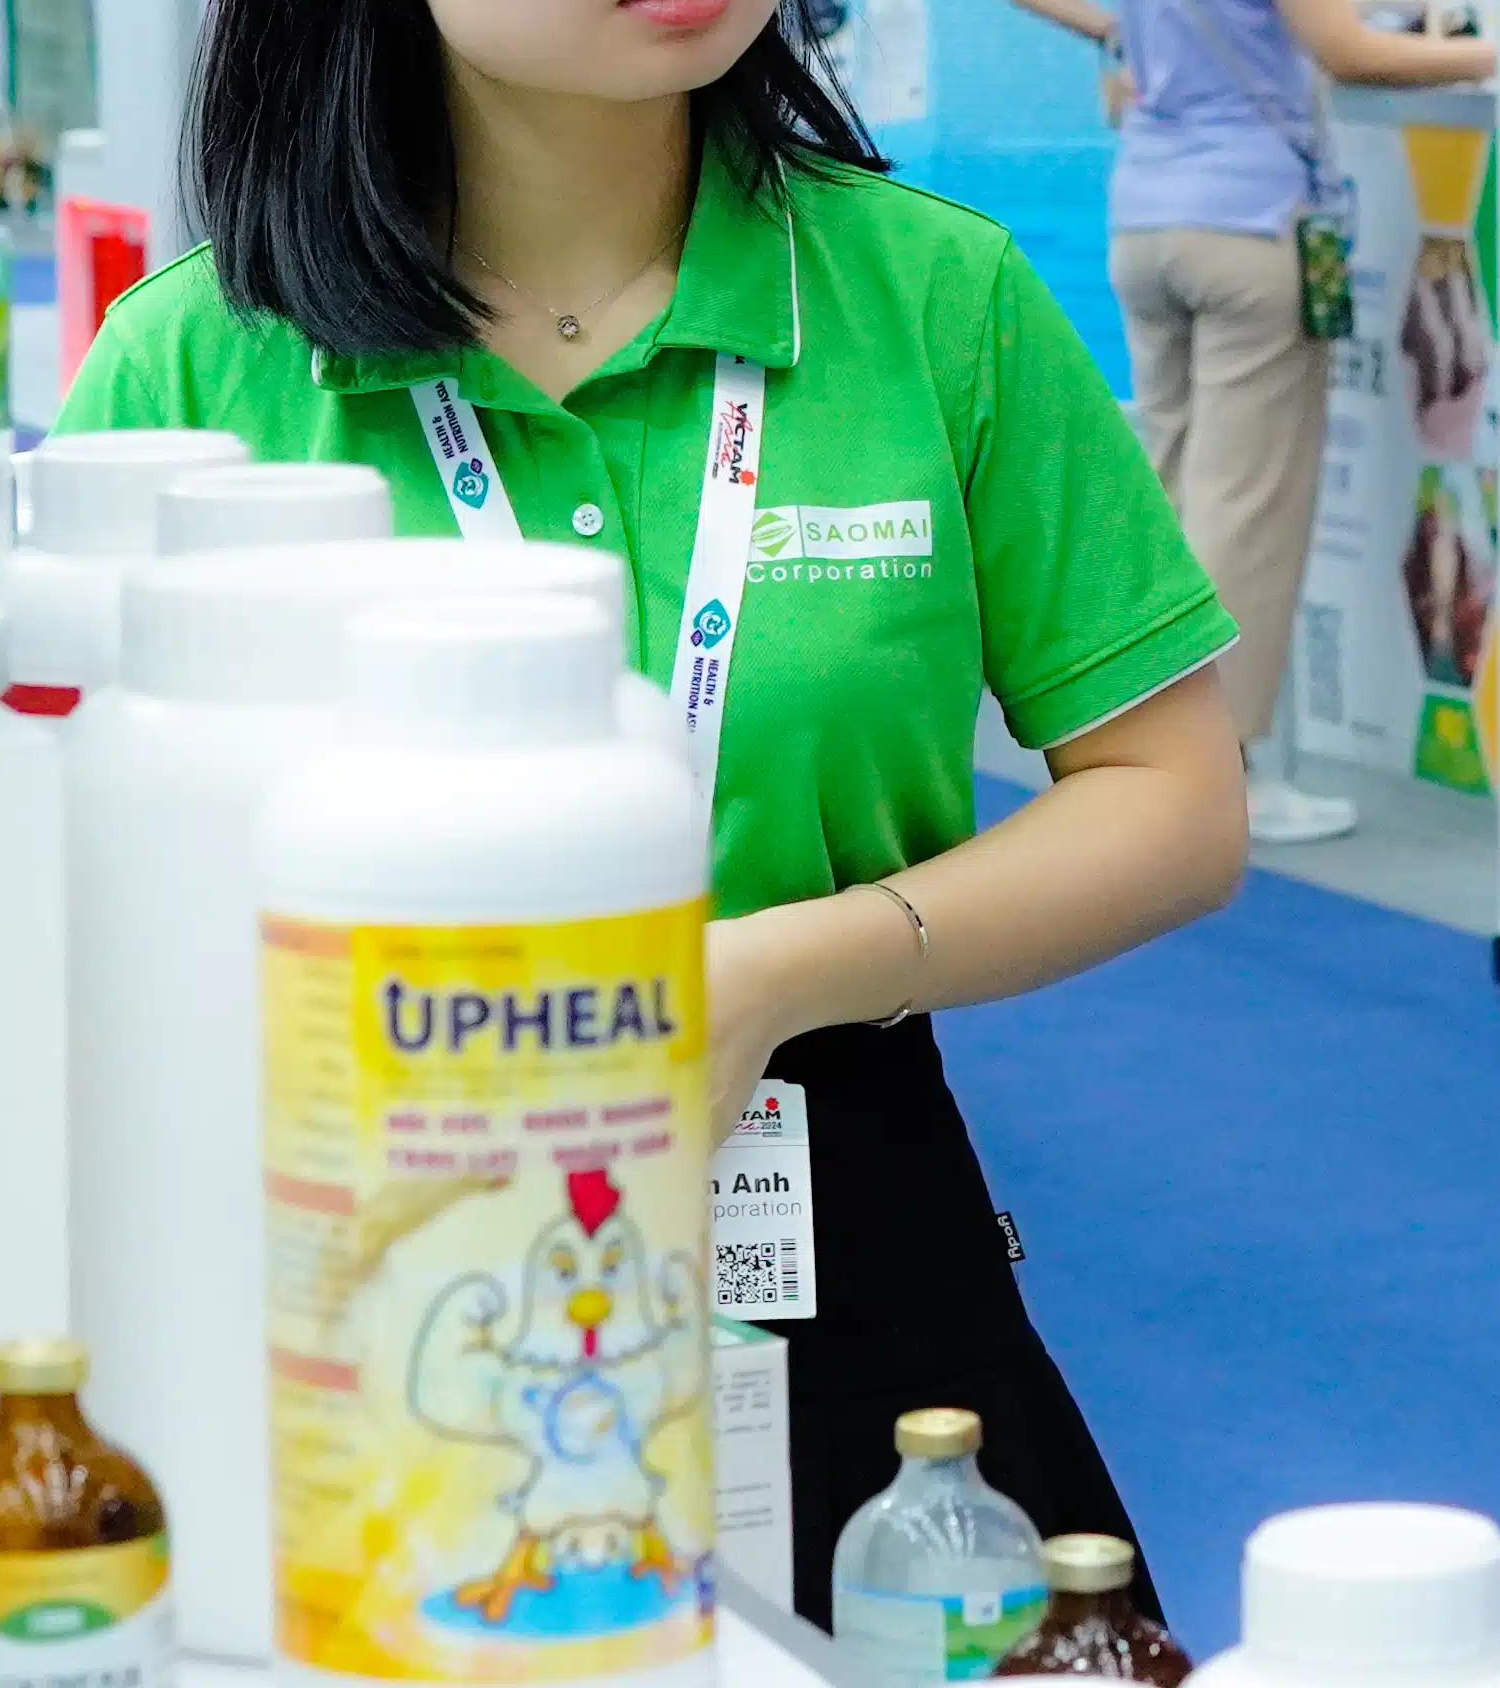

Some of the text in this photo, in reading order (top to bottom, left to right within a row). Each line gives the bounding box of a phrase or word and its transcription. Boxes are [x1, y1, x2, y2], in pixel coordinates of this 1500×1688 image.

[435, 381, 468, 453] NUTRITION ASIA
[435, 427, 455, 459] HEALTH
[727, 403, 747, 484] VICTAM
[806, 516, 929, 544] SAOMAI
[746, 559, 934, 585] Corporation
[688, 657, 704, 710] NUTRITION
[705, 658, 720, 695] HEALTH
[385, 976, 676, 1053] UPHEAL
[732, 1172, 790, 1194] Anh
[710, 1201, 802, 1223] poration
[997, 1213, 1021, 1259] yody
